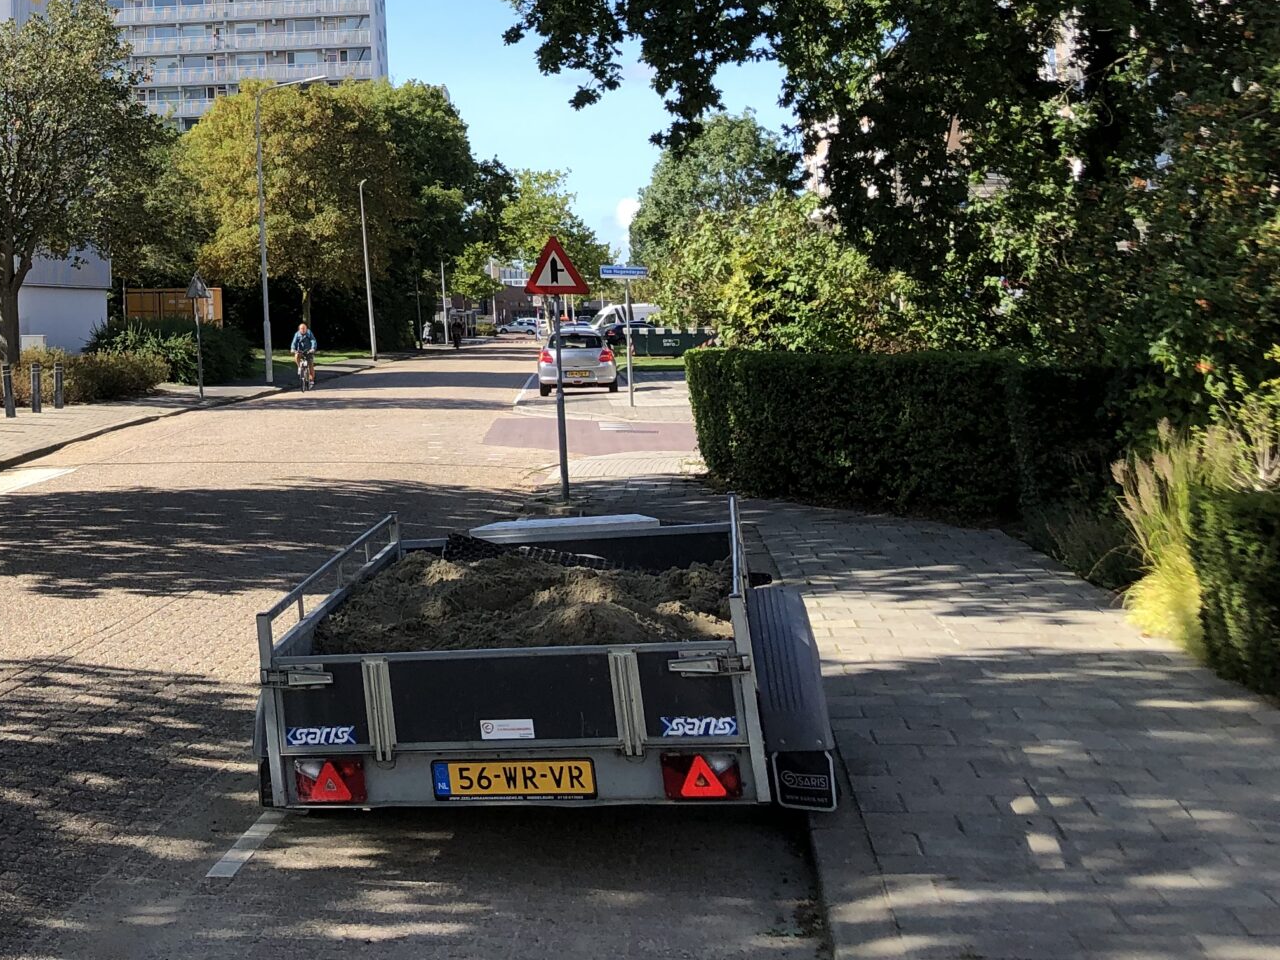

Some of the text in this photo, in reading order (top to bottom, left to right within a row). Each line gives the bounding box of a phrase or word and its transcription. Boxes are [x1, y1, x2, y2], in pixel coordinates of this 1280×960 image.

[668, 716, 732, 735] saris
[292, 727, 350, 745] saris
[438, 766, 586, 790] NL 56-WR-VR
[798, 776, 826, 787] SARIS
